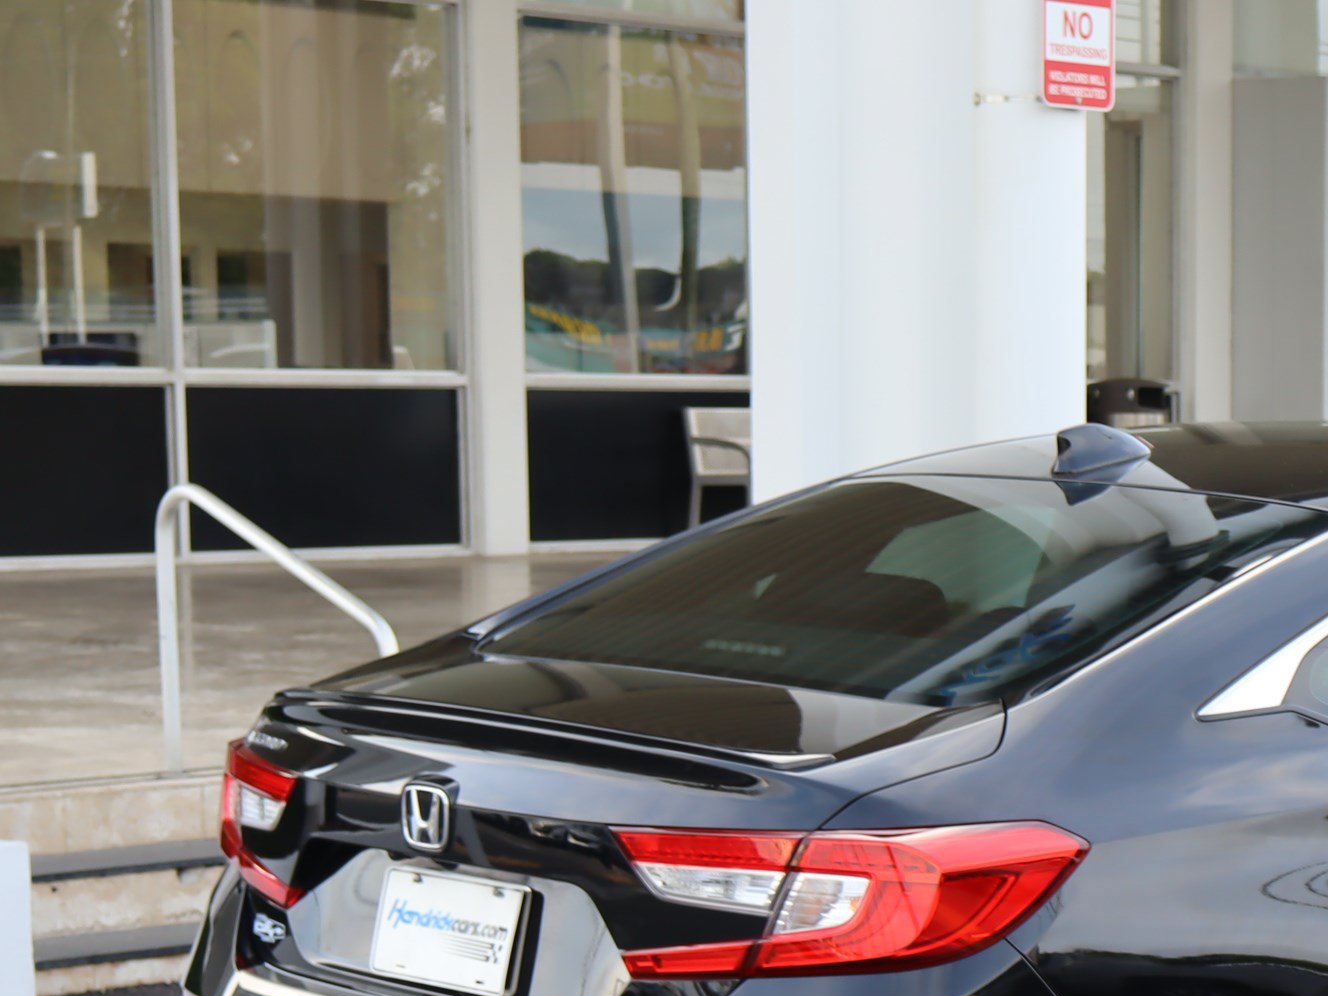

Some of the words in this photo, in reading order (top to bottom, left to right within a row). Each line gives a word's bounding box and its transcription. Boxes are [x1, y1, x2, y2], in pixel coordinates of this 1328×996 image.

[1063, 10, 1093, 39] NO
[1050, 43, 1107, 59] TRESPASSING
[1049, 70, 1089, 83] VIOLATORS
[1048, 83, 1058, 95] BE
[1060, 84, 1107, 99] PROSECUTED
[387, 899, 508, 942] Hendrickcars.com
